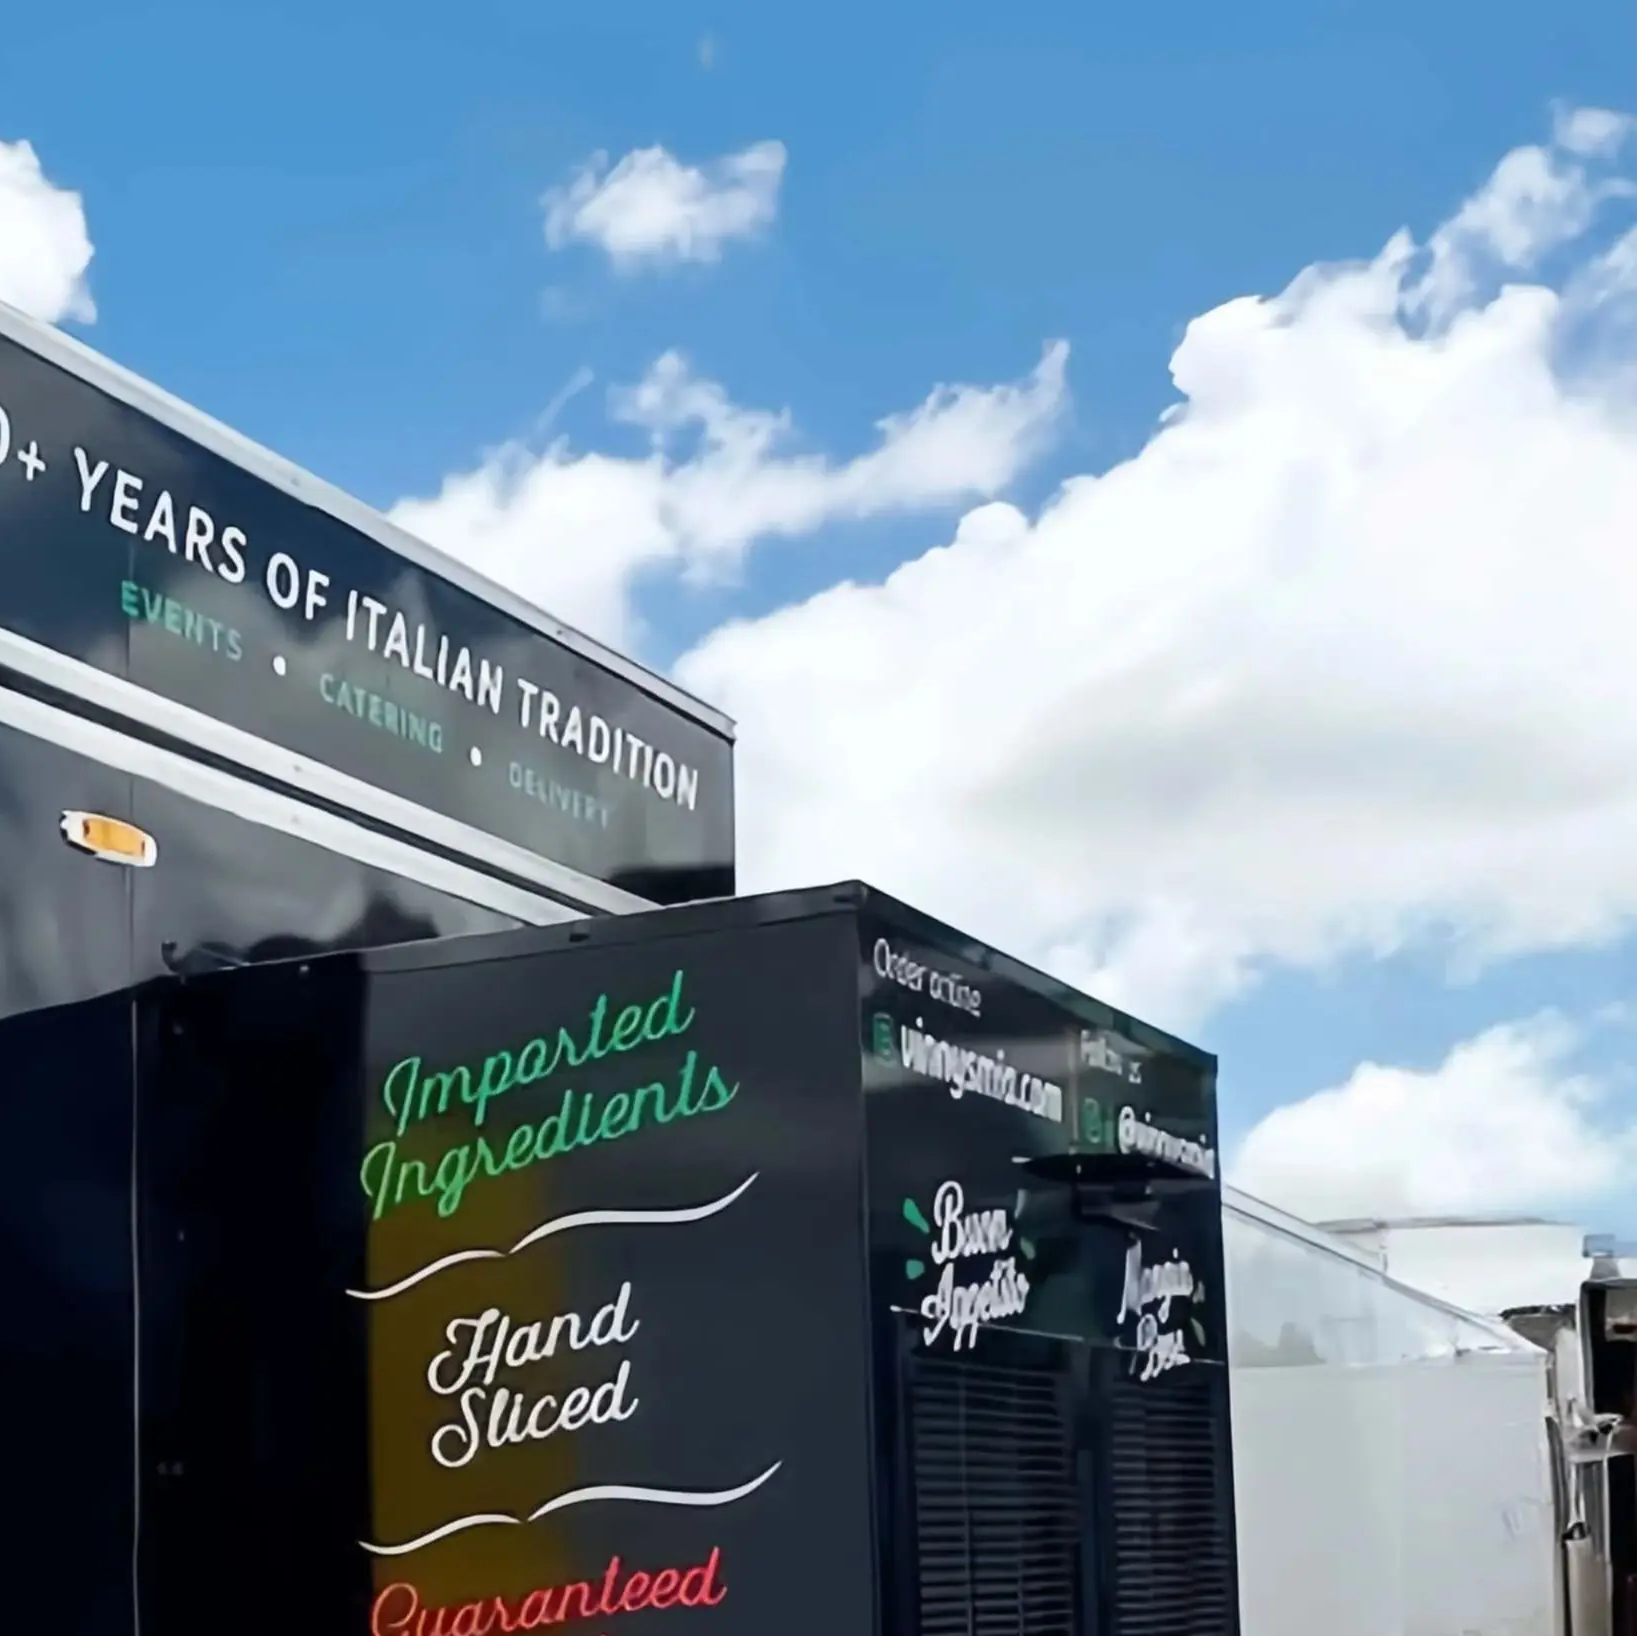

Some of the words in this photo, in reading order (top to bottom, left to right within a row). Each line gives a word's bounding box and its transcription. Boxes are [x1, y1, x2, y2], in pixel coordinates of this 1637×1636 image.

[72, 446, 249, 584] YEARS
[266, 552, 331, 621] OF
[345, 589, 504, 715] ITALIAN
[516, 677, 700, 812] TRADITION
[119, 578, 244, 663] EVENTS
[318, 671, 444, 755] CATERING
[508, 760, 612, 831] DELIVERY
[358, 1050, 740, 1221] Ingredients
[382, 968, 696, 1137] Imported
[426, 1280, 640, 1397] Hand
[430, 1360, 639, 1469] Sliced
